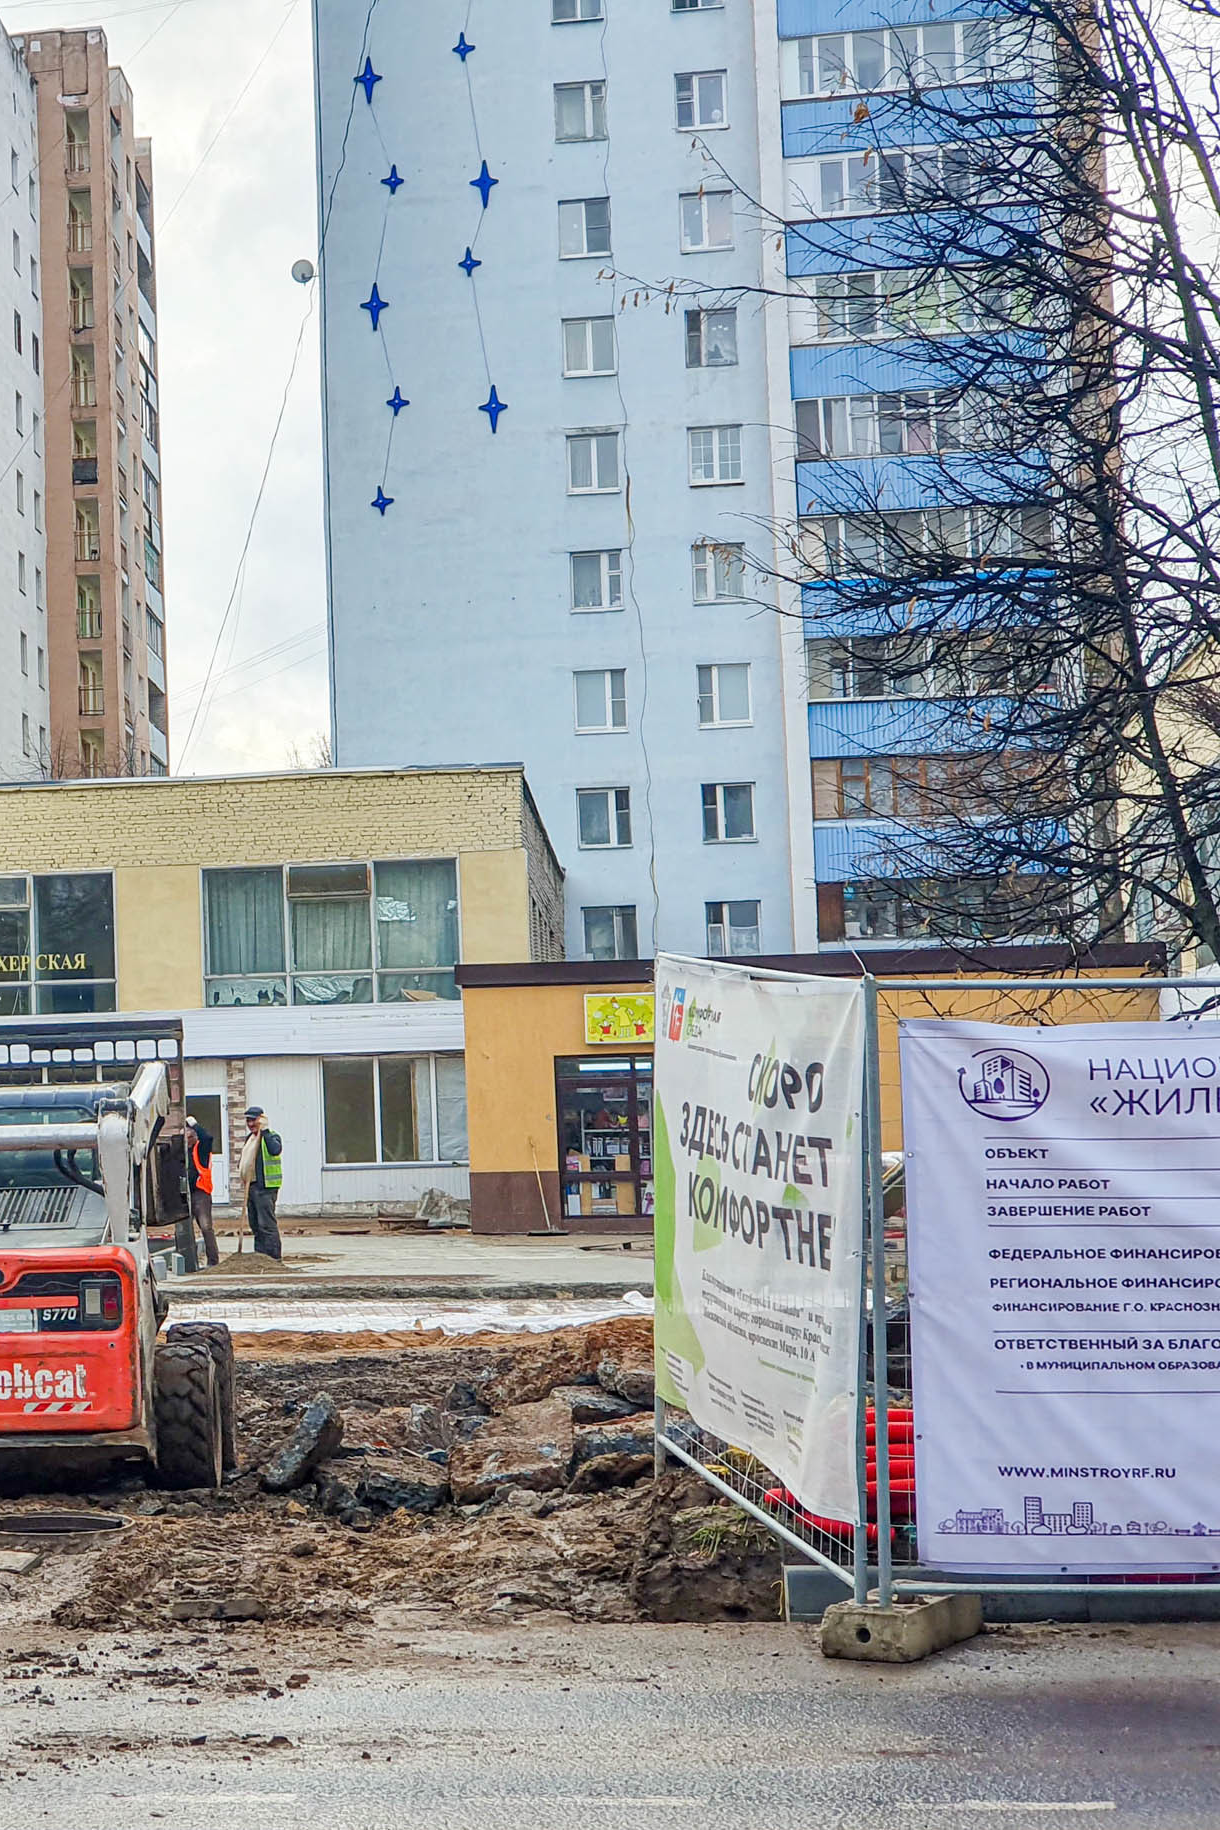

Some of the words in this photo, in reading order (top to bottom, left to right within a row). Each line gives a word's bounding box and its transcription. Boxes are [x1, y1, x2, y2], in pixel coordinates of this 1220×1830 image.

[1089, 1057, 1220, 1084] НАЦИО
[749, 1053, 824, 1113] СКОРО
[1090, 1087, 1220, 1115] «ЖИЛ
[680, 1101, 729, 1163] ЗДЕСЬ
[733, 1121, 833, 1187] СТАНЕТ
[985, 1149, 1049, 1159] ОБЪЕКТ
[986, 1179, 1055, 1190] НАЧАЛО
[1058, 1179, 1110, 1190] РАБОТ
[987, 1205, 1095, 1217] ЗАВЕРШЕНИЕ
[1098, 1206, 1151, 1217] РАБОТ
[689, 1171, 836, 1272] КОМФОРТНЕ
[988, 1248, 1107, 1261] ФЕДЕРАЛЬНОЕ
[990, 1277, 1118, 1289] РЕГИОНАЛЬНОЕ
[992, 1302, 1120, 1312] ФИНАНСИРОВАНИЕ
[1123, 1302, 1147, 1312] Г.О.
[42, 1308, 77, 1321] S770
[994, 1336, 1138, 1350] ОТВЕТСТВЕННЫЙ
[1142, 1339, 1164, 1350] ЗА
[1168, 1339, 1220, 1350] БЛАГО
[1036, 1361, 1156, 1372] МУНИЦИПАЛЬНОМ
[998, 1465, 1176, 1479] WWW.MINSTROYRF.RU
